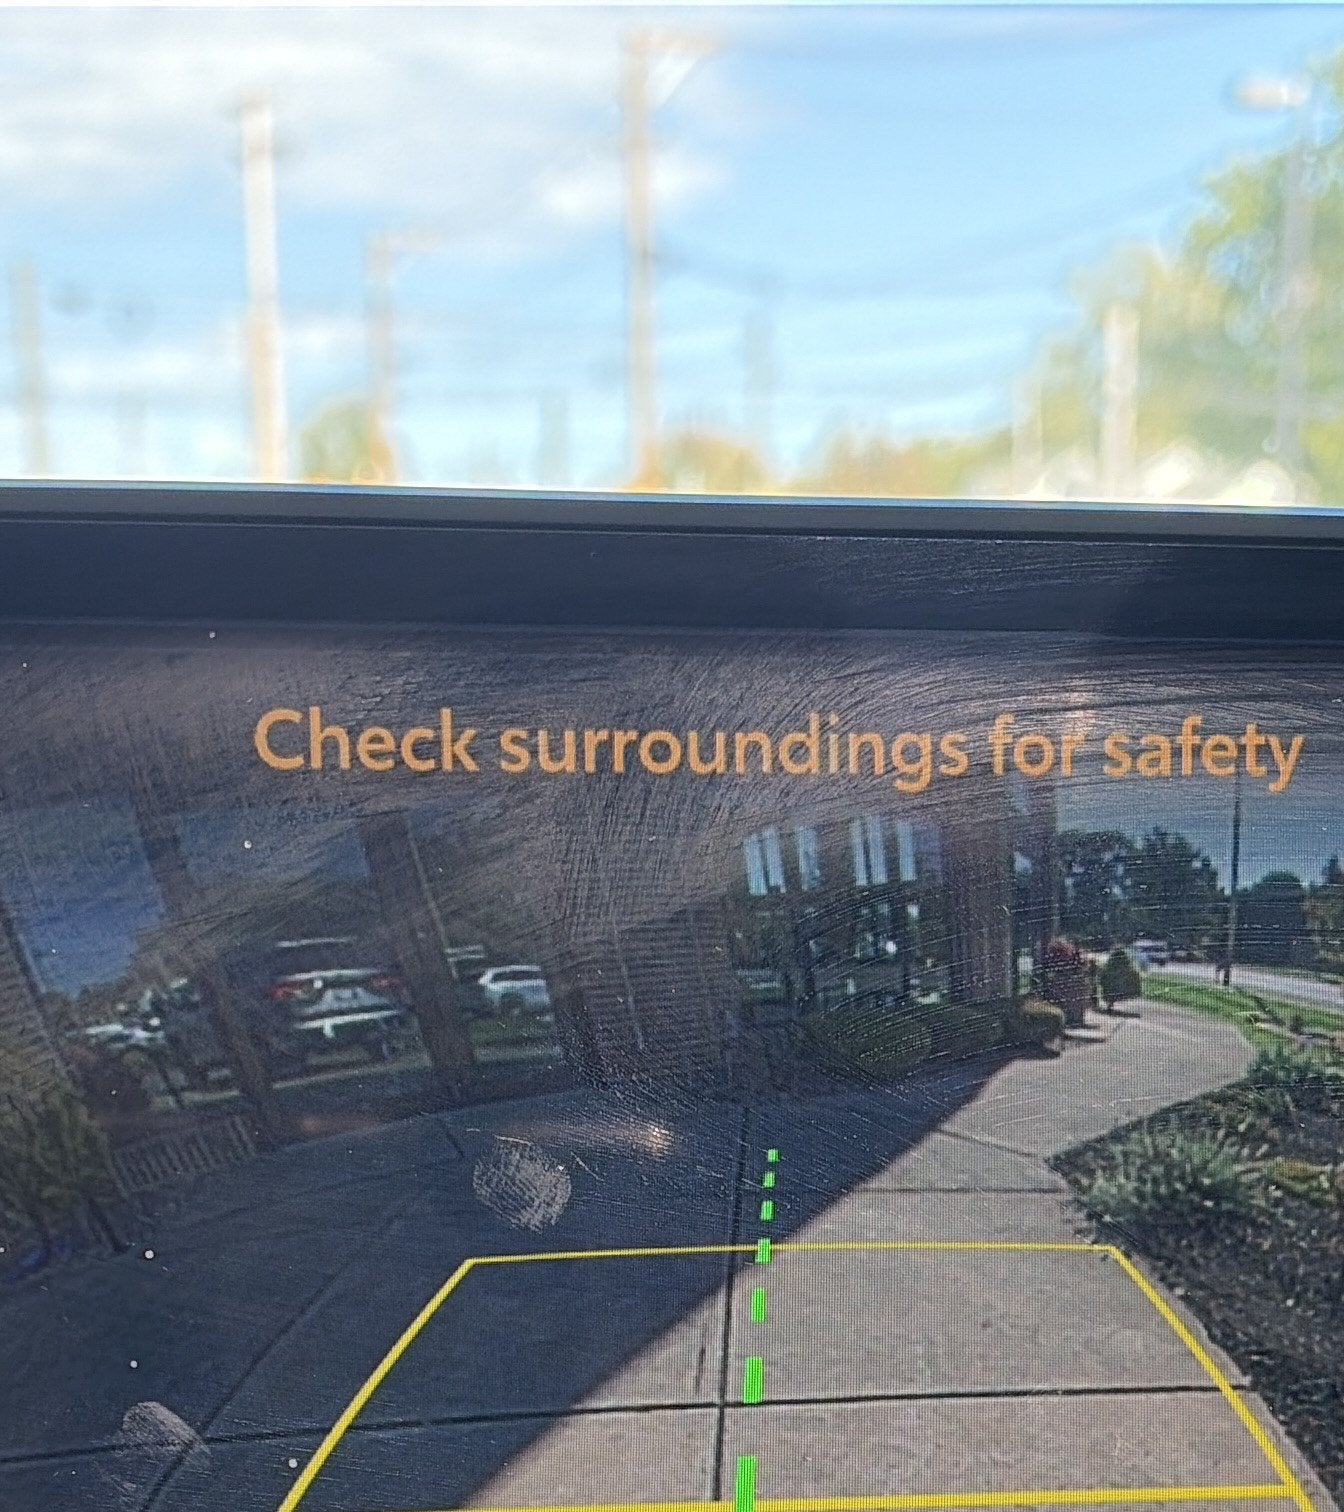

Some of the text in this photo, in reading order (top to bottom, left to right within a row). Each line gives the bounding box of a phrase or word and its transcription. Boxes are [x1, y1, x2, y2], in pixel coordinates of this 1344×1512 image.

[253, 707, 1306, 794] Check surroundings for safety
